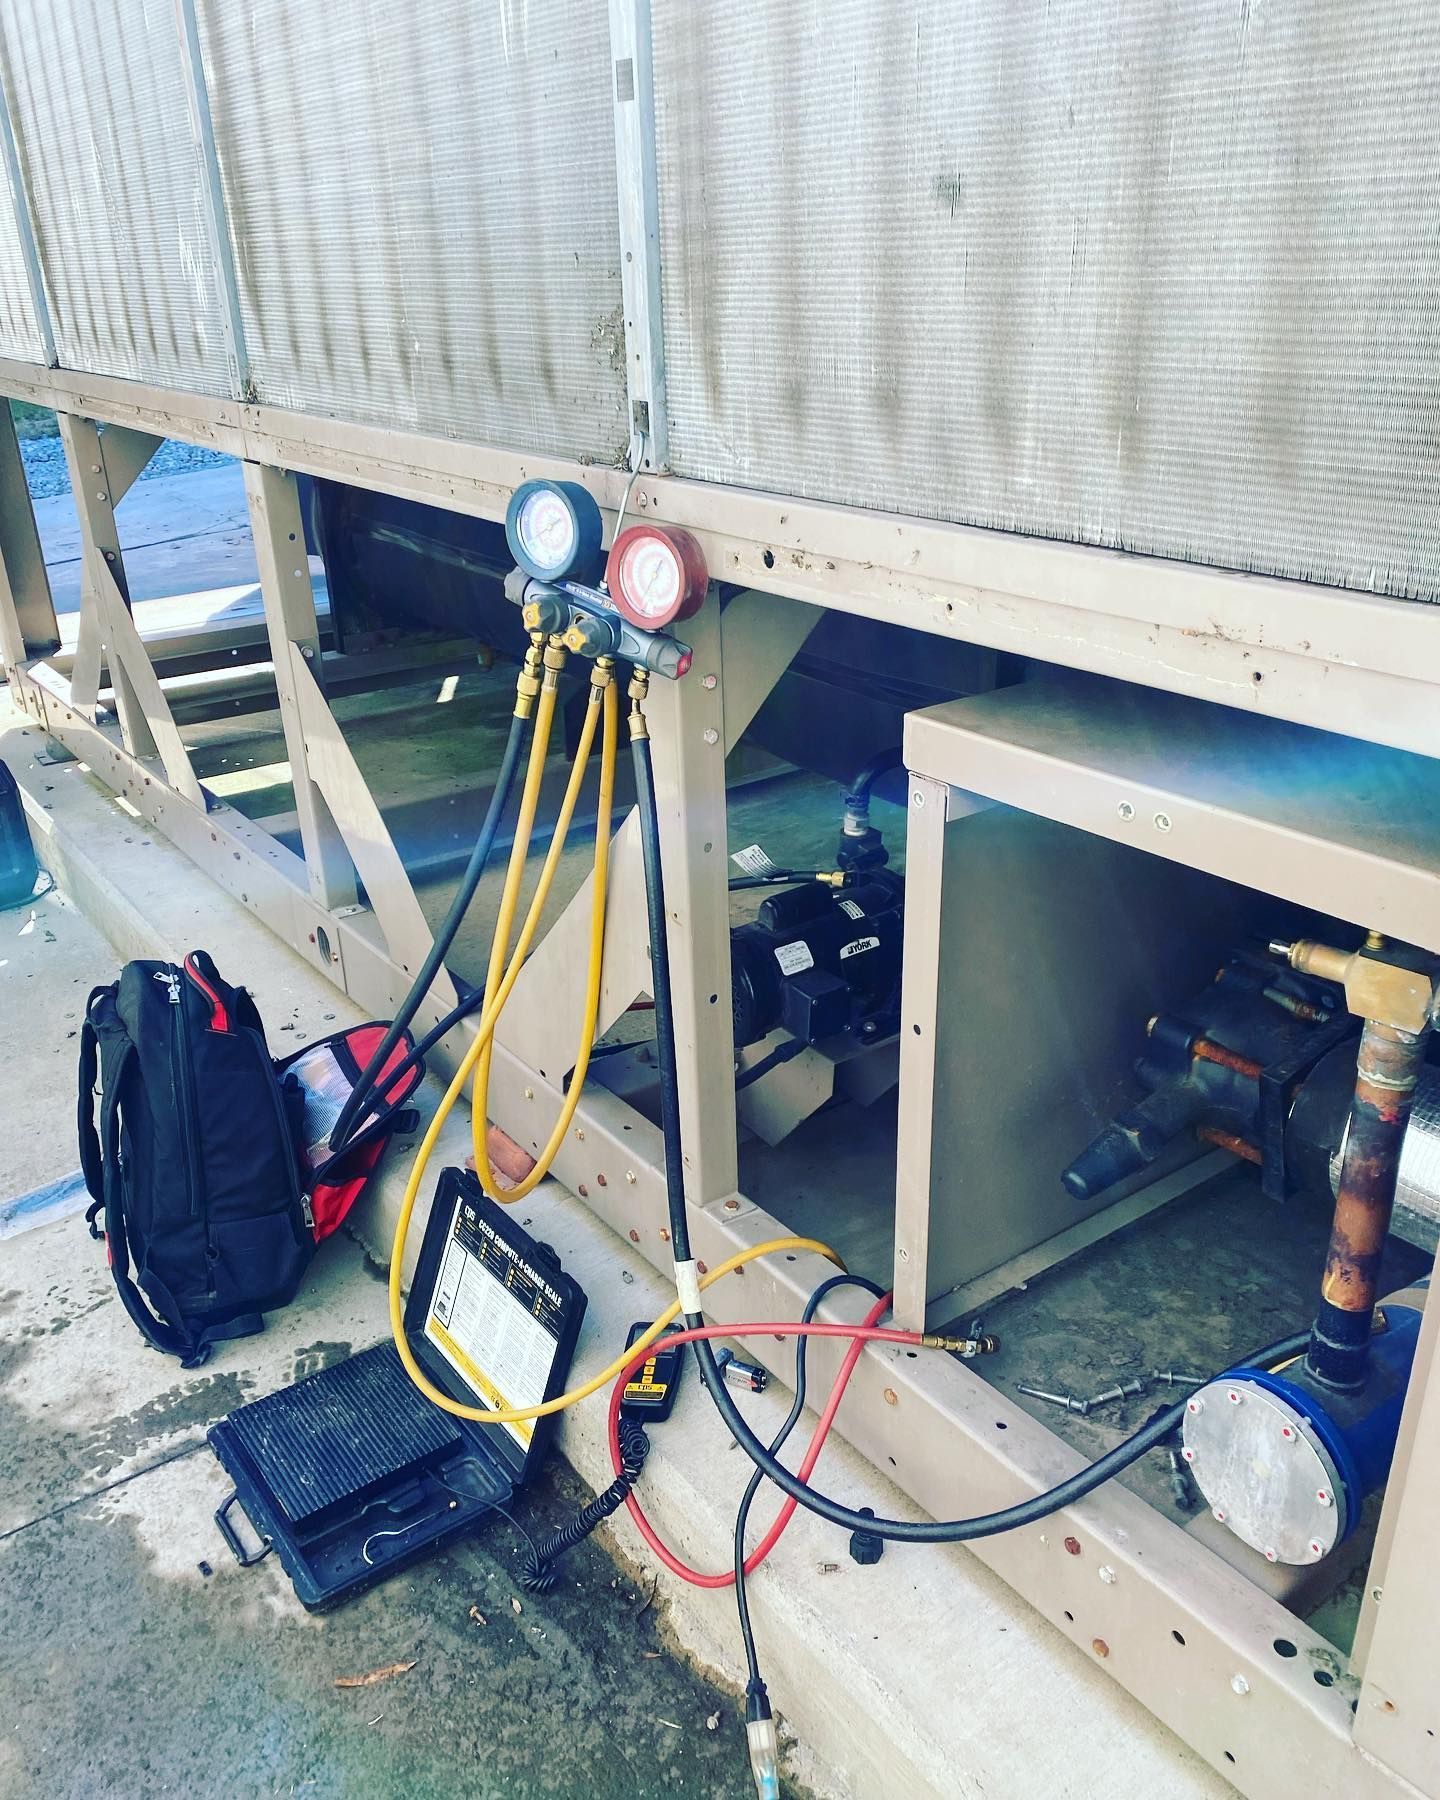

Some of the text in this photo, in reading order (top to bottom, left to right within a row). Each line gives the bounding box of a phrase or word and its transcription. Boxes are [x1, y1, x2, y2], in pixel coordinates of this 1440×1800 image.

[853, 940, 872, 952] YORK
[494, 1234, 546, 1290] COMPUTE-A-CHARGE
[544, 1284, 562, 1307] SCALE
